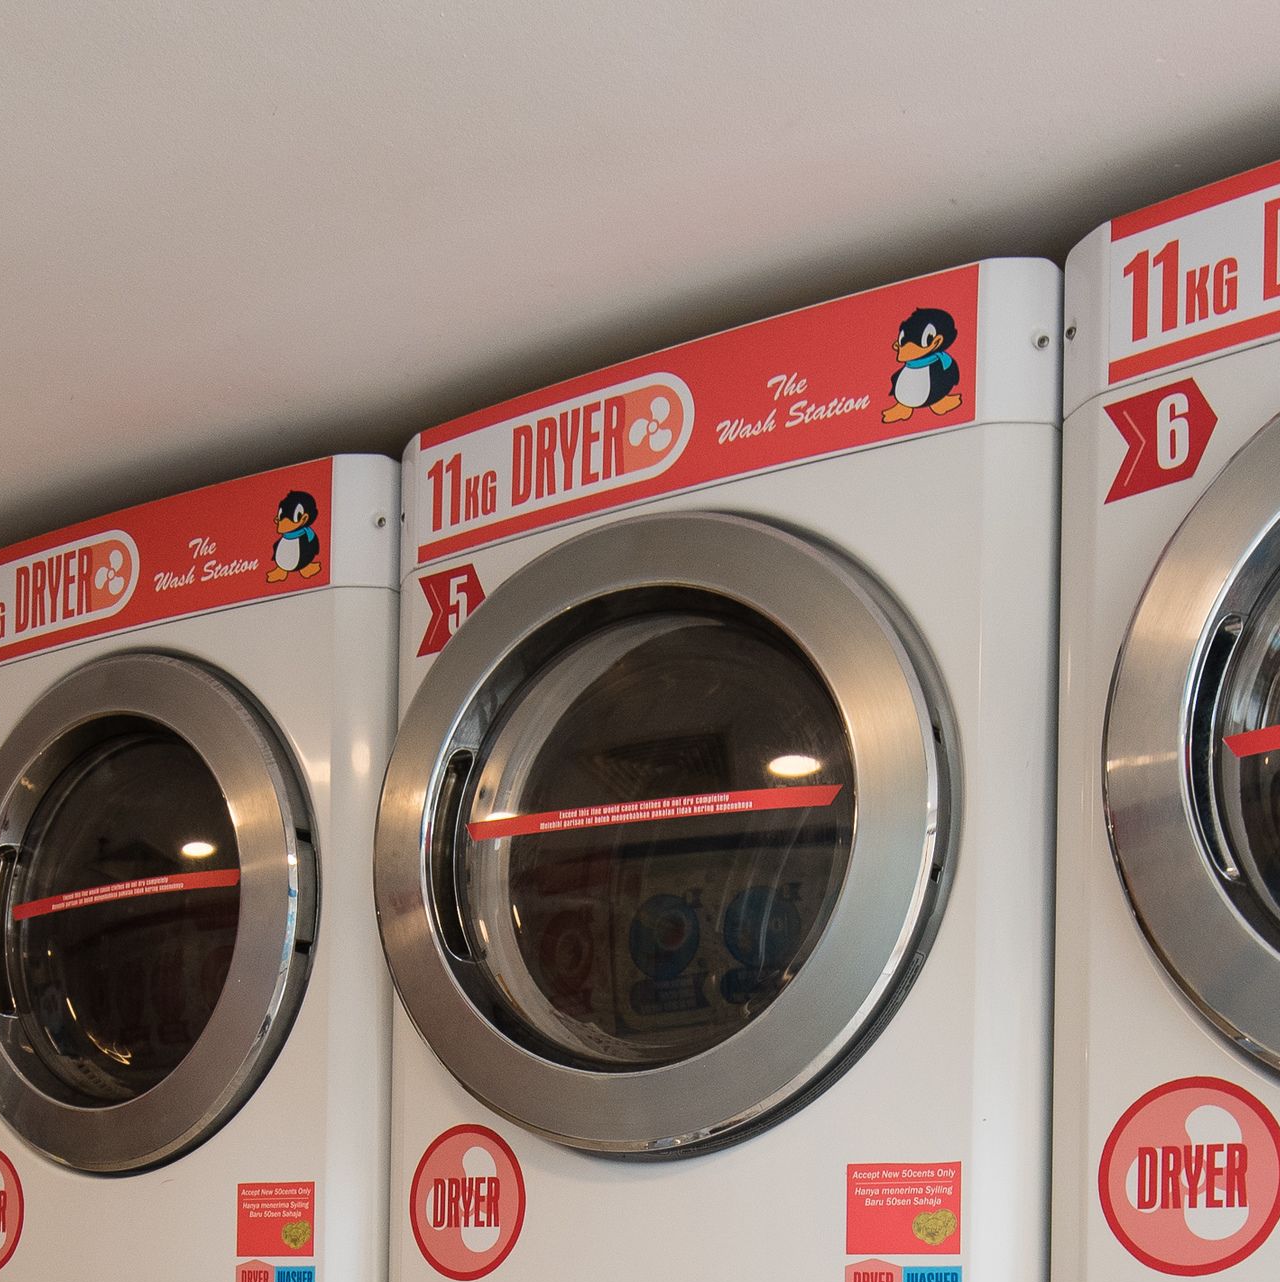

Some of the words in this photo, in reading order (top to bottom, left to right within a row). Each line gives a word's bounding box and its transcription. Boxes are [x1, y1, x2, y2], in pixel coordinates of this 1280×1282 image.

[1123, 238, 1239, 342] 11KG
[767, 372, 807, 398] The
[717, 415, 776, 444] Wash
[786, 393, 870, 431] Station
[1154, 392, 1191, 470] 6
[427, 451, 497, 532] 11KG
[512, 395, 625, 508] DRYER
[188, 537, 217, 559] The
[16, 546, 94, 634] DRYER
[154, 571, 195, 593] Wash
[201, 557, 260, 583] Station
[448, 575, 468, 628] 5
[852, 1170, 880, 1180] Accept
[882, 1170, 899, 1178] New
[937, 1168, 956, 1179] Only
[855, 1187, 880, 1196] Hanya
[882, 1186, 923, 1195] menerima
[1137, 1143, 1248, 1210] DRYER
[433, 1177, 500, 1227] DRYER
[865, 1198, 884, 1206] Baru
[914, 1197, 942, 1207] Sahaja
